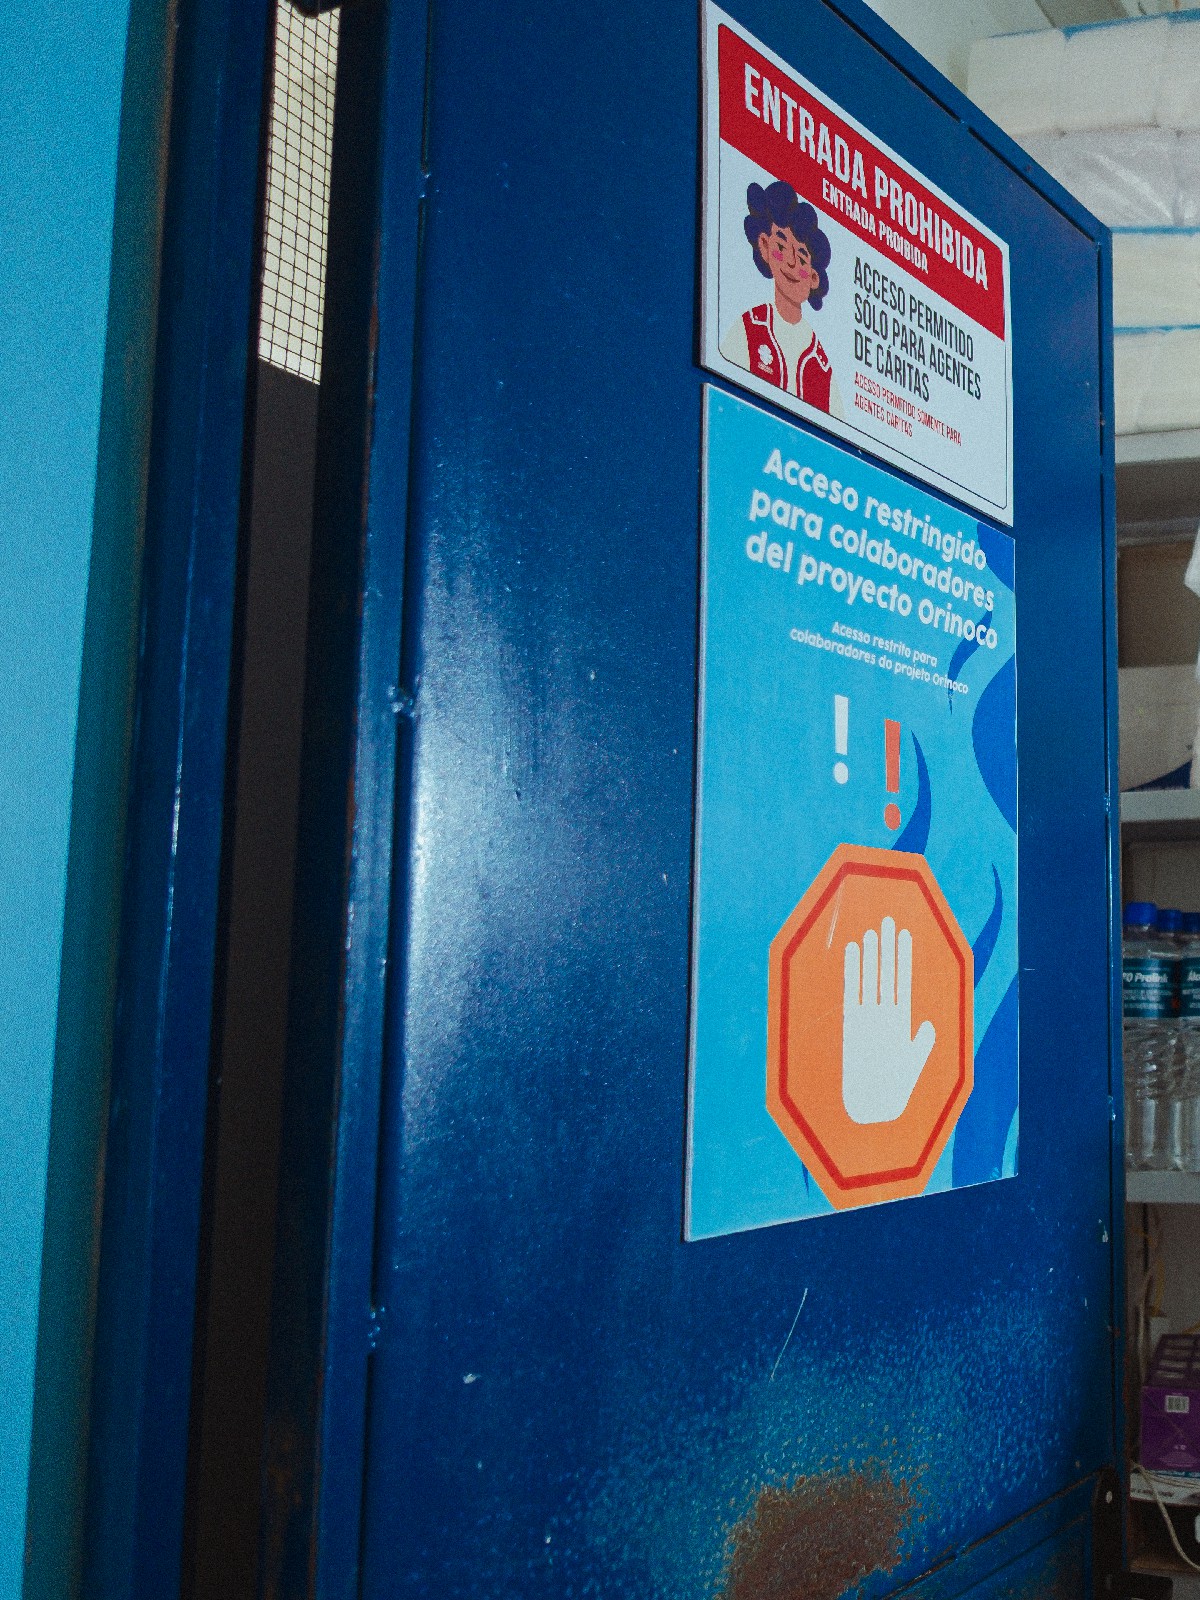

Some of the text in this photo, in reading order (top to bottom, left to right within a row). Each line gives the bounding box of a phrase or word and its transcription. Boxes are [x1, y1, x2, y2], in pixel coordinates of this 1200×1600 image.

[744, 62, 988, 291] ENTRADA PROHIBIDA
[822, 178, 929, 274] ENTRADA PROIBIDA
[854, 256, 974, 362] ACCESO PERMITIDO
[854, 292, 981, 400] SÓLO PARA AGENTES
[854, 329, 930, 402] DE CÁRITAS
[854, 392, 885, 422] AGENTES
[854, 371, 962, 447] ACESSO PERMITIDO SOMENTE PARA
[748, 489, 995, 612] para colaboradores
[763, 447, 987, 571] Acceso restringido
[746, 531, 998, 650] del proyecto Orinoco
[789, 627, 969, 695] colaboradores do projeto Orinoco
[831, 621, 938, 668] Acesso restrito para
